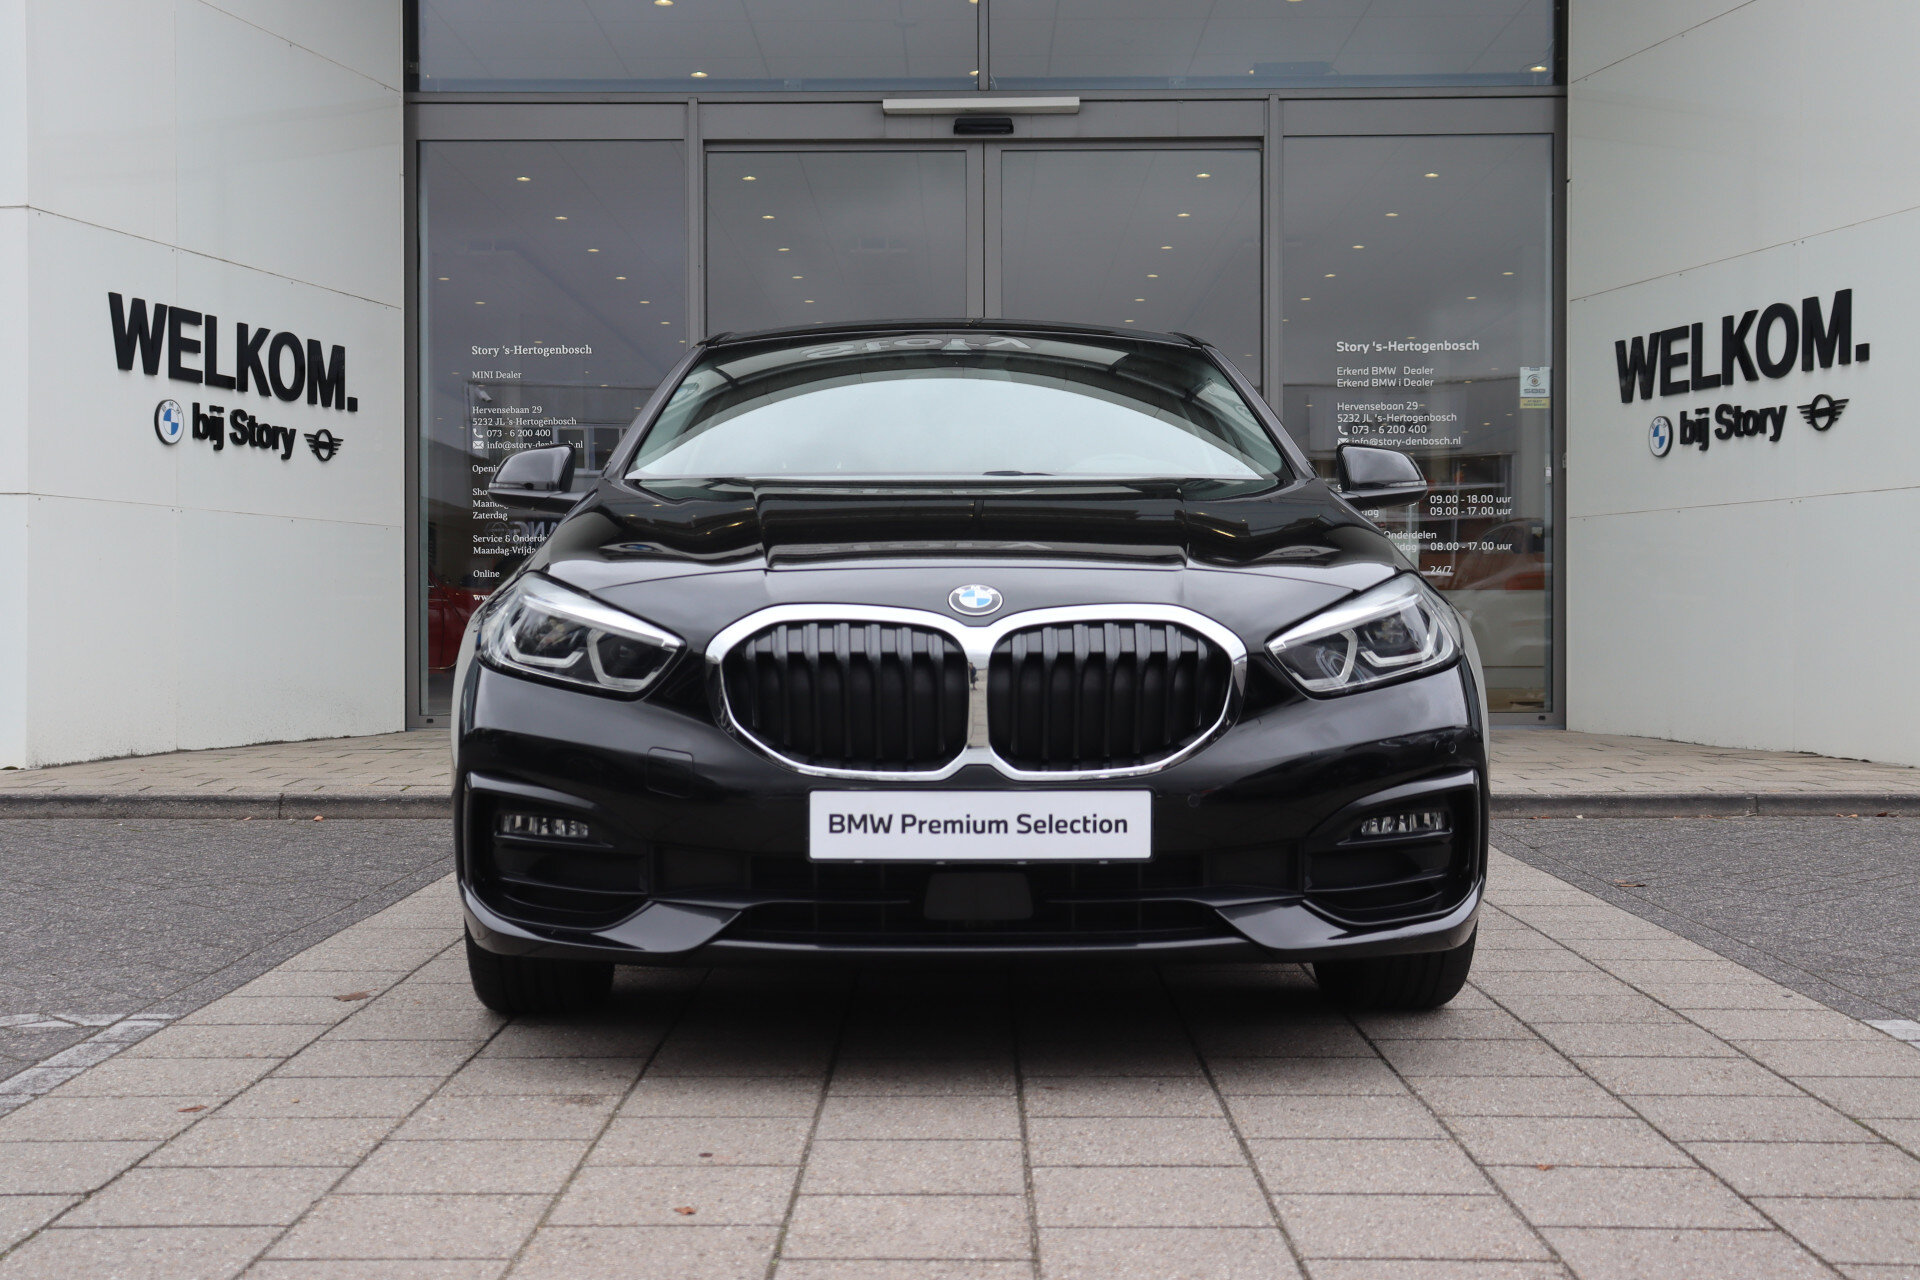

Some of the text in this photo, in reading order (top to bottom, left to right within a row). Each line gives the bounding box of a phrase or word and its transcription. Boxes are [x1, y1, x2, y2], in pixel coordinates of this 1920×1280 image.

[471, 345, 500, 357] Story
[1336, 340, 1480, 354] Story 's-Hertogenbosch
[1614, 288, 1870, 404] WELKOM.
[107, 291, 358, 413] WELKOM.
[471, 370, 522, 379] MINI Dealer
[1336, 366, 1434, 376] Erkend BMW Dealer
[1336, 378, 1369, 388] Erkend
[1371, 378, 1397, 387] BMW
[1403, 377, 1434, 387] Dealer
[472, 405, 543, 414] Hervensebaan 29
[1337, 401, 1419, 411] Hervensebaan 29
[472, 417, 493, 426] 5232
[494, 417, 506, 426] JL
[1337, 413, 1457, 424] 5232 JL 's-Hertogenbosch
[192, 402, 297, 461] bij Story
[1351, 425, 1369, 434] 073
[1378, 425, 1385, 434] 6
[1386, 425, 1406, 434] 200
[1408, 424, 1427, 434] 400
[1679, 403, 1788, 451] bij Story
[486, 429, 503, 437] 073
[509, 429, 516, 437] 6
[517, 429, 533, 437] 200
[534, 429, 551, 437] 400
[1430, 495, 1459, 504] 09.00
[1466, 494, 1494, 504] 18.00
[472, 511, 508, 521] Zaterdag
[1430, 507, 1459, 516] 09.00
[472, 534, 549, 543] Service & Onderde
[472, 546, 537, 556] Maandag-Vrijda
[1430, 542, 1459, 551] 08.00
[473, 569, 500, 578] Online
[1430, 565, 1452, 574] 24/7
[828, 813, 1129, 834] BMW Premium Selection
